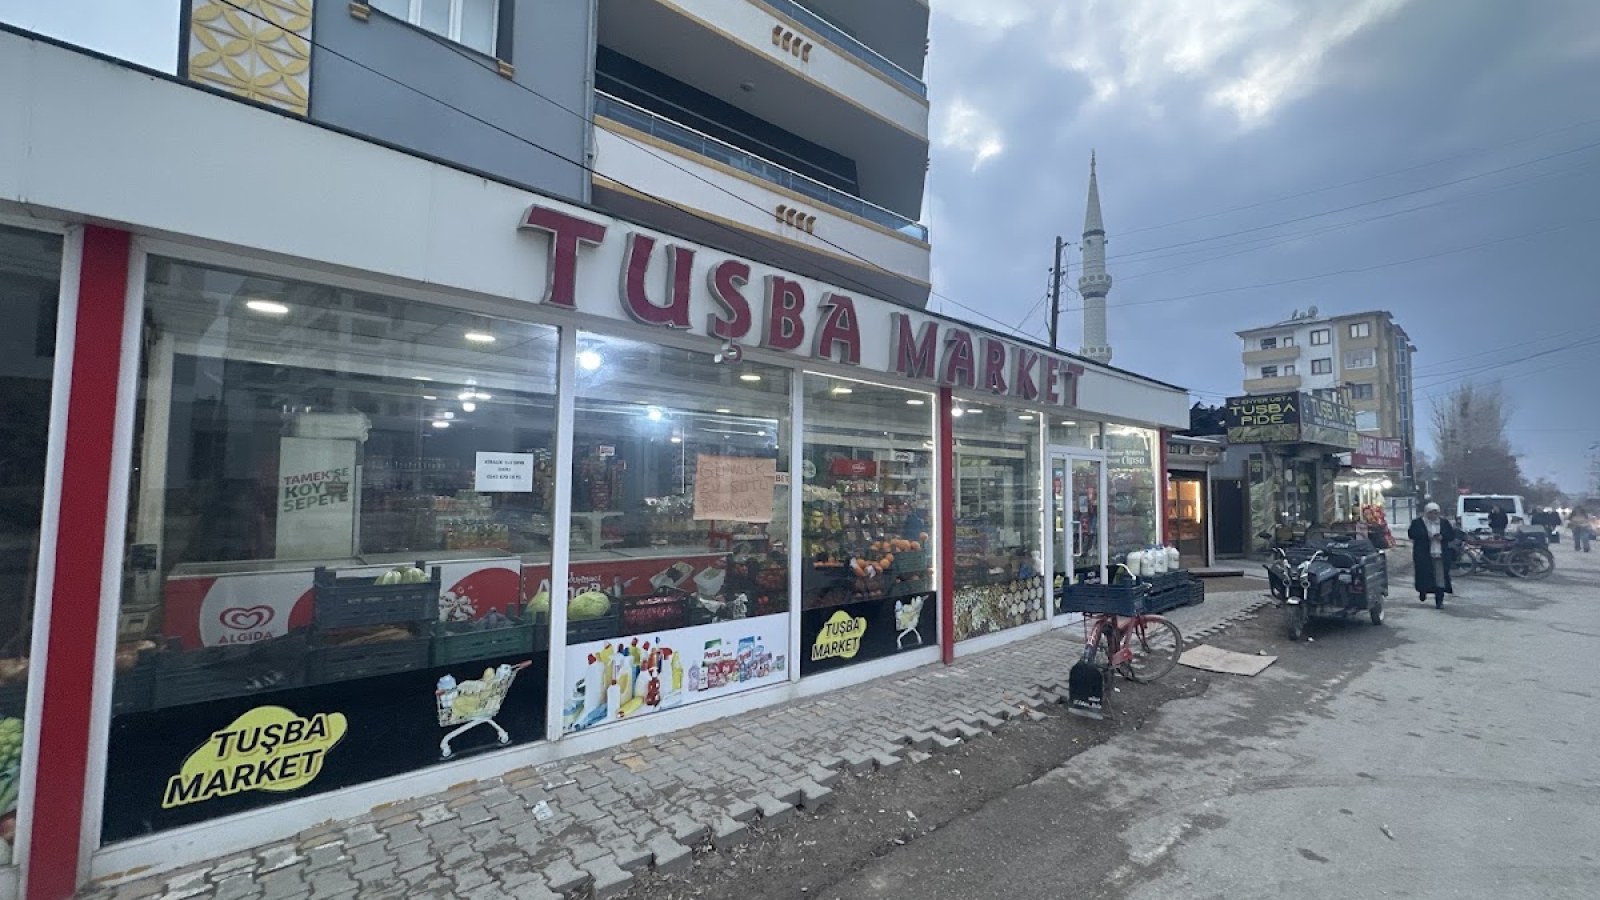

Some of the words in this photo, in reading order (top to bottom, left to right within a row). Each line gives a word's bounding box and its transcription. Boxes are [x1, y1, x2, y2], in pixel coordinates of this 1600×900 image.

[518, 203, 861, 364] TUŞBA
[888, 312, 1084, 407] MARKET
[1229, 403, 1296, 416] TUŞBA
[285, 481, 323, 499] KOY
[284, 494, 348, 513] SEPETE
[825, 618, 860, 637] TUŞBA
[812, 637, 859, 659] MARKET
[214, 715, 326, 757] TUŞBA
[166, 749, 322, 804] MARKET
